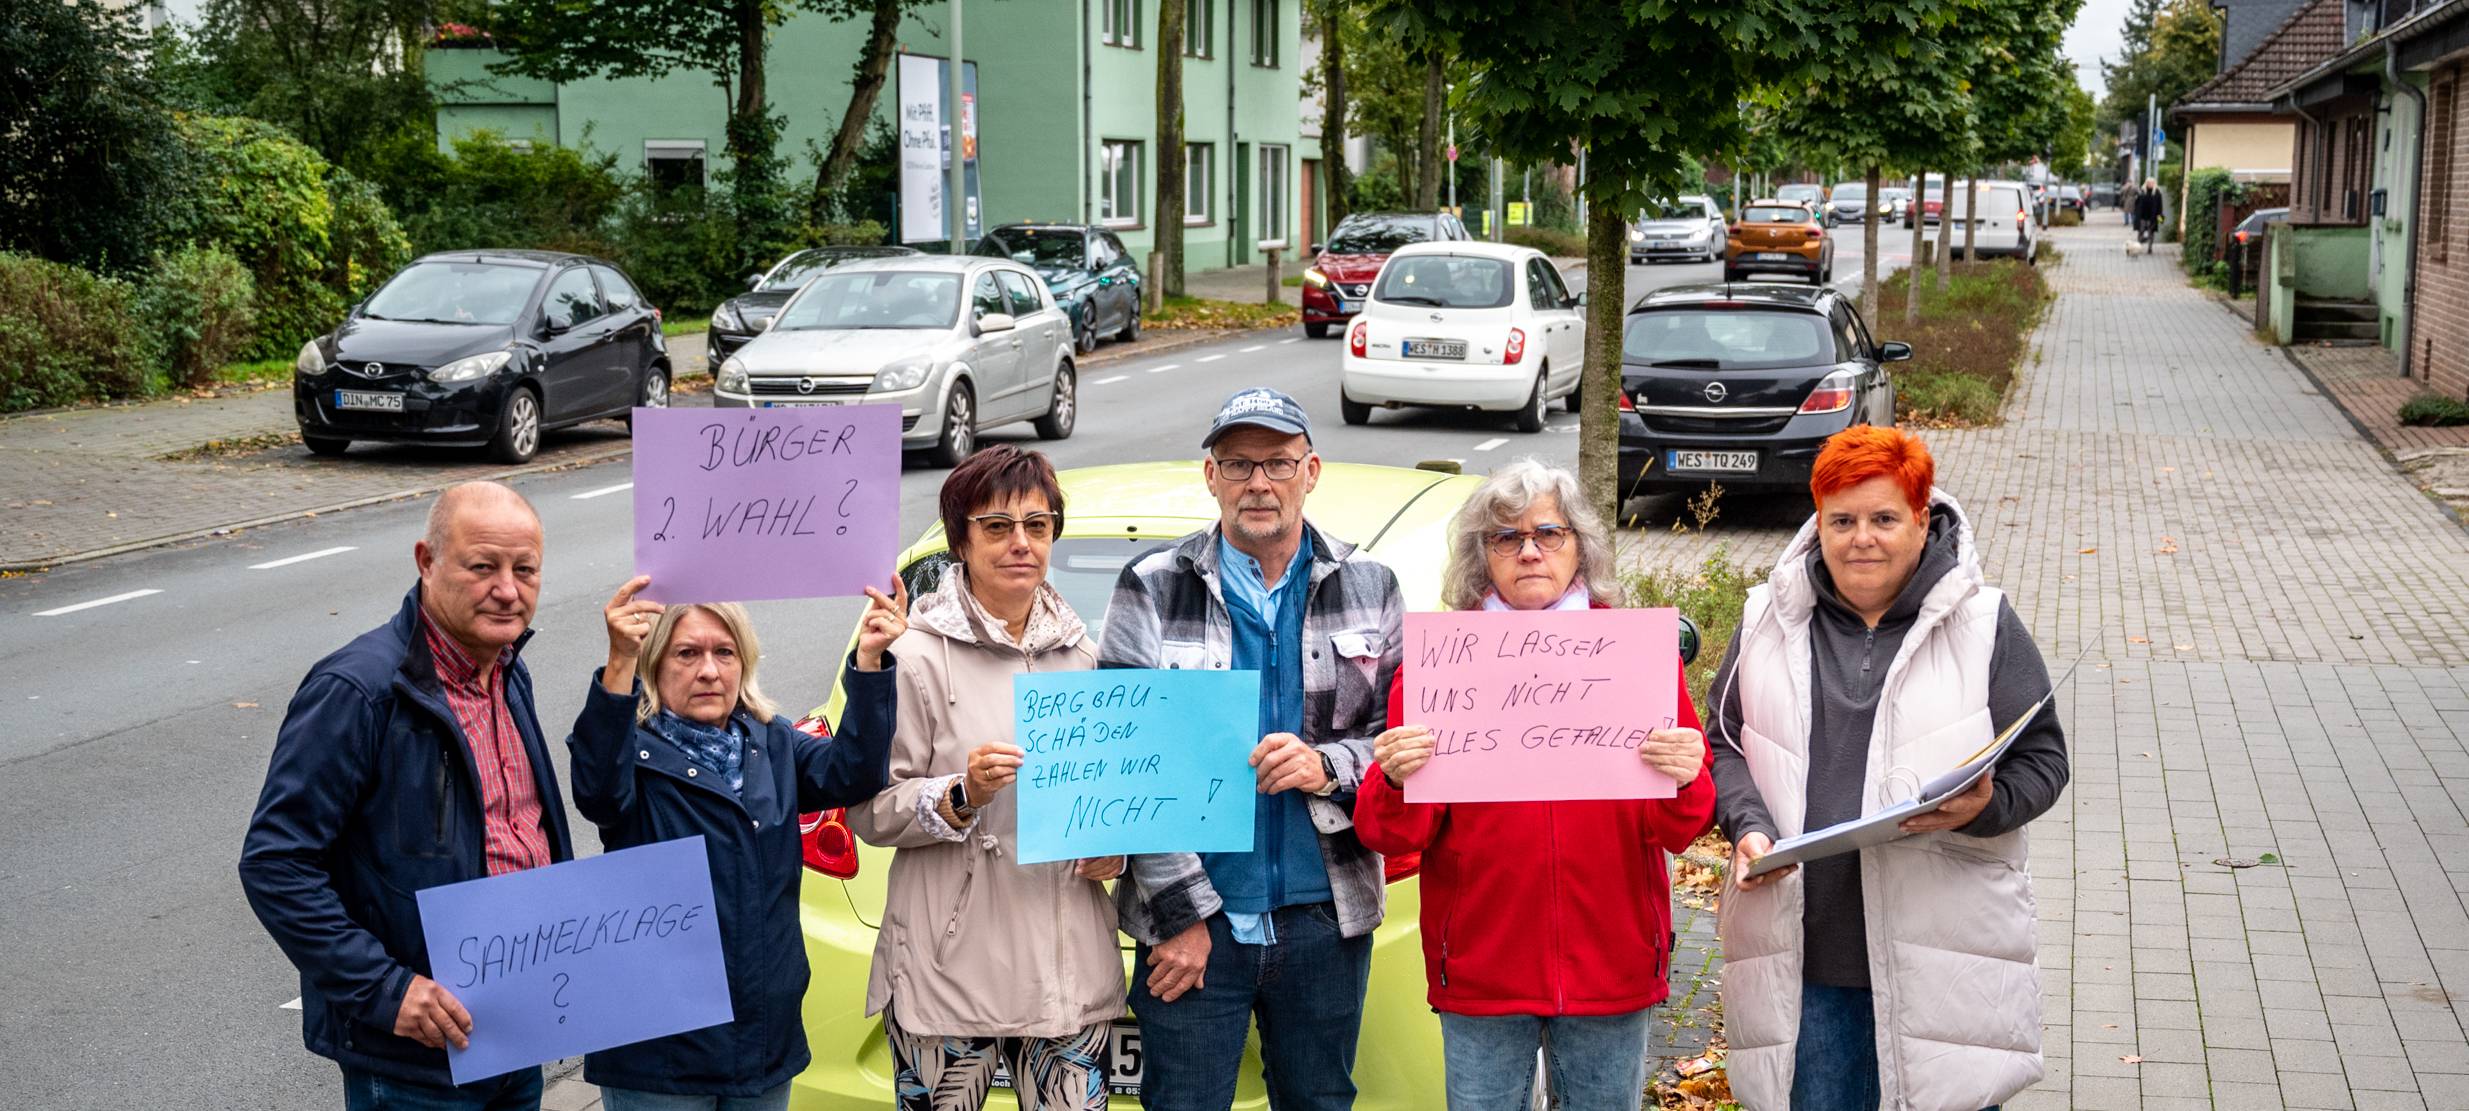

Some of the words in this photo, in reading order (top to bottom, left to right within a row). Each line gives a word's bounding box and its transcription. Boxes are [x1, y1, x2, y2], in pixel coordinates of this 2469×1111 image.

[1408, 343, 1426, 354] WES
[343, 393, 363, 406] DIN
[369, 395, 385, 407] MC
[387, 396, 401, 408] 75
[699, 415, 856, 471] BÜRGER
[1677, 453, 1703, 467] WES
[1712, 453, 1729, 468] TQ
[1732, 454, 1755, 468] 249
[653, 496, 676, 541] 2.
[702, 495, 816, 540] WAHL
[1497, 630, 1617, 658] LASSEN
[1421, 686, 1477, 713] UNS
[1032, 759, 1108, 789] ZAHLEN
[1120, 753, 1161, 775] WIR
[1064, 795, 1178, 838] NICHT
[456, 903, 704, 988] SAMMELKLAGE
[552, 972, 571, 1025] ?
